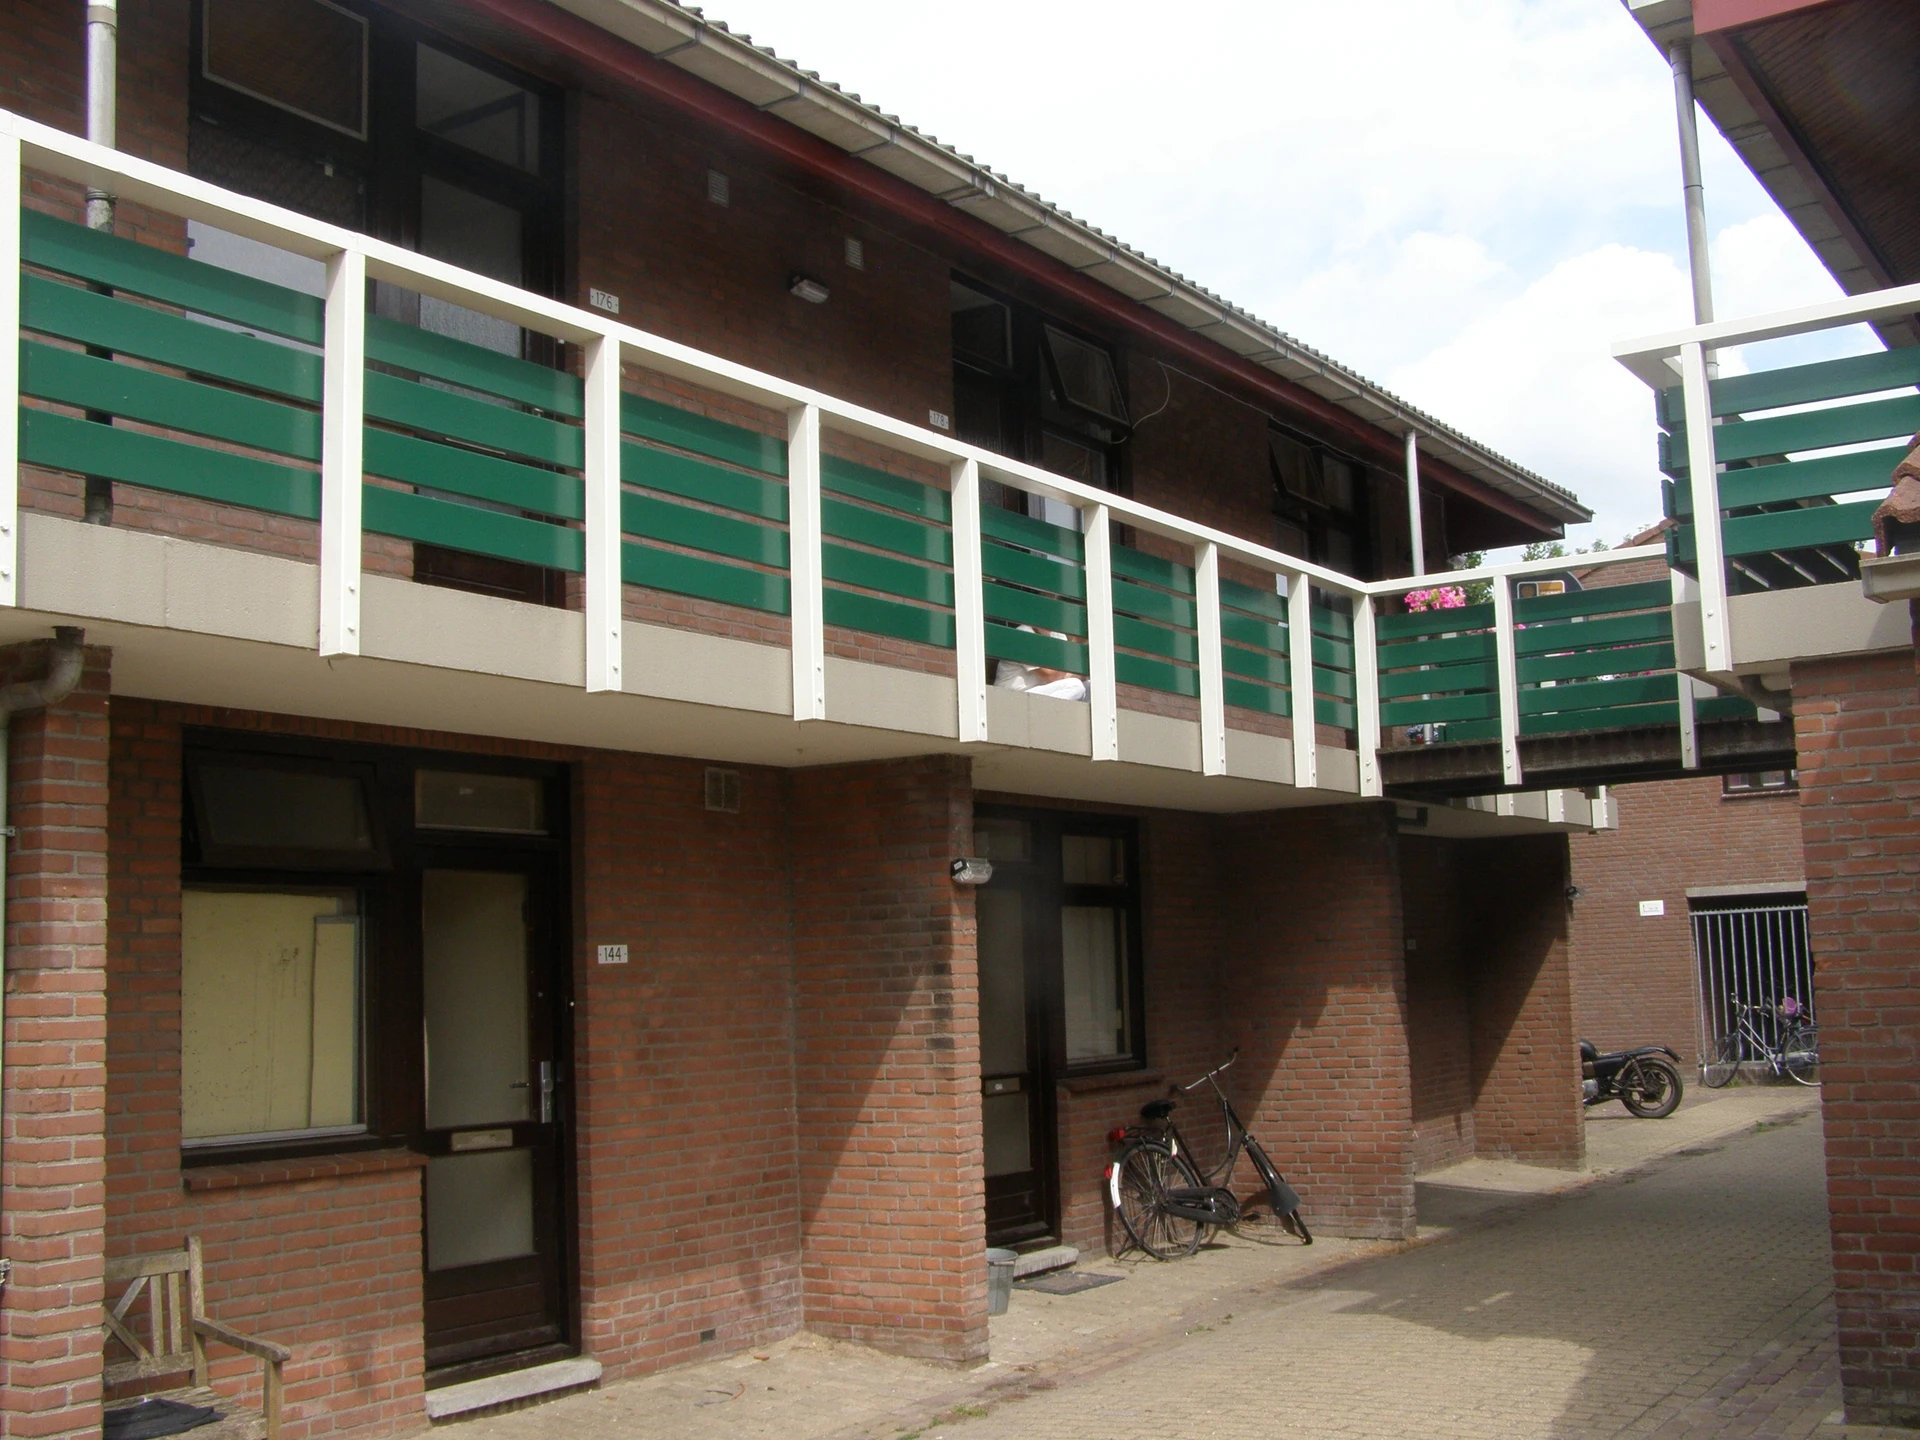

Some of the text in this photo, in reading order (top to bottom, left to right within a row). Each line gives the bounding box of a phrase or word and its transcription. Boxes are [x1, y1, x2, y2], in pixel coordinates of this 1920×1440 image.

[596, 291, 613, 310] 176
[933, 412, 945, 427] 178
[604, 946, 622, 962] 144
